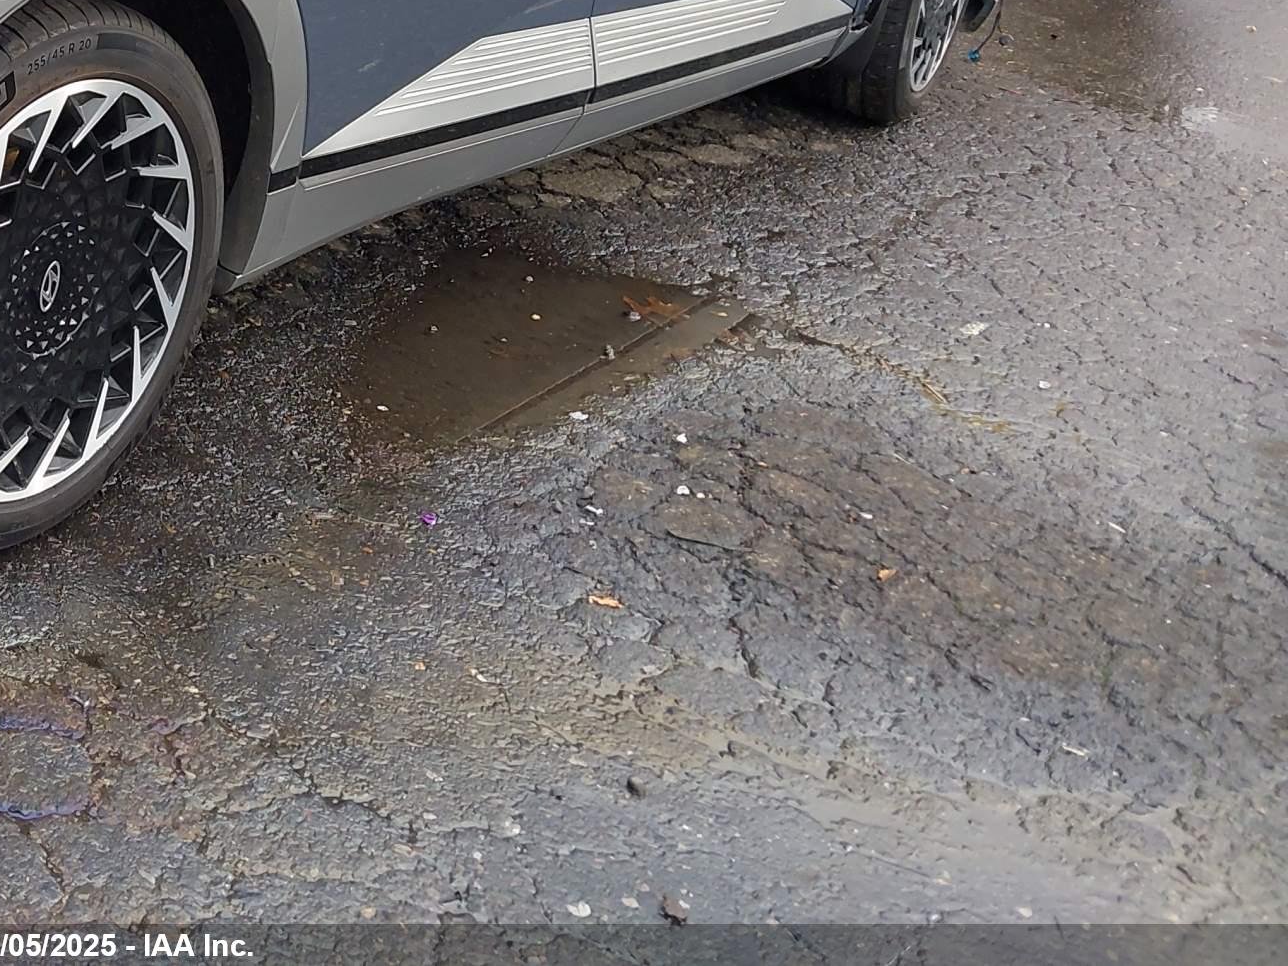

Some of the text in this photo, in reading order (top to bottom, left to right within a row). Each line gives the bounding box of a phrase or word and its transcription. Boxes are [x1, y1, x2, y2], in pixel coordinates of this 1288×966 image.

[27, 37, 92, 75] 255/45 R 20
